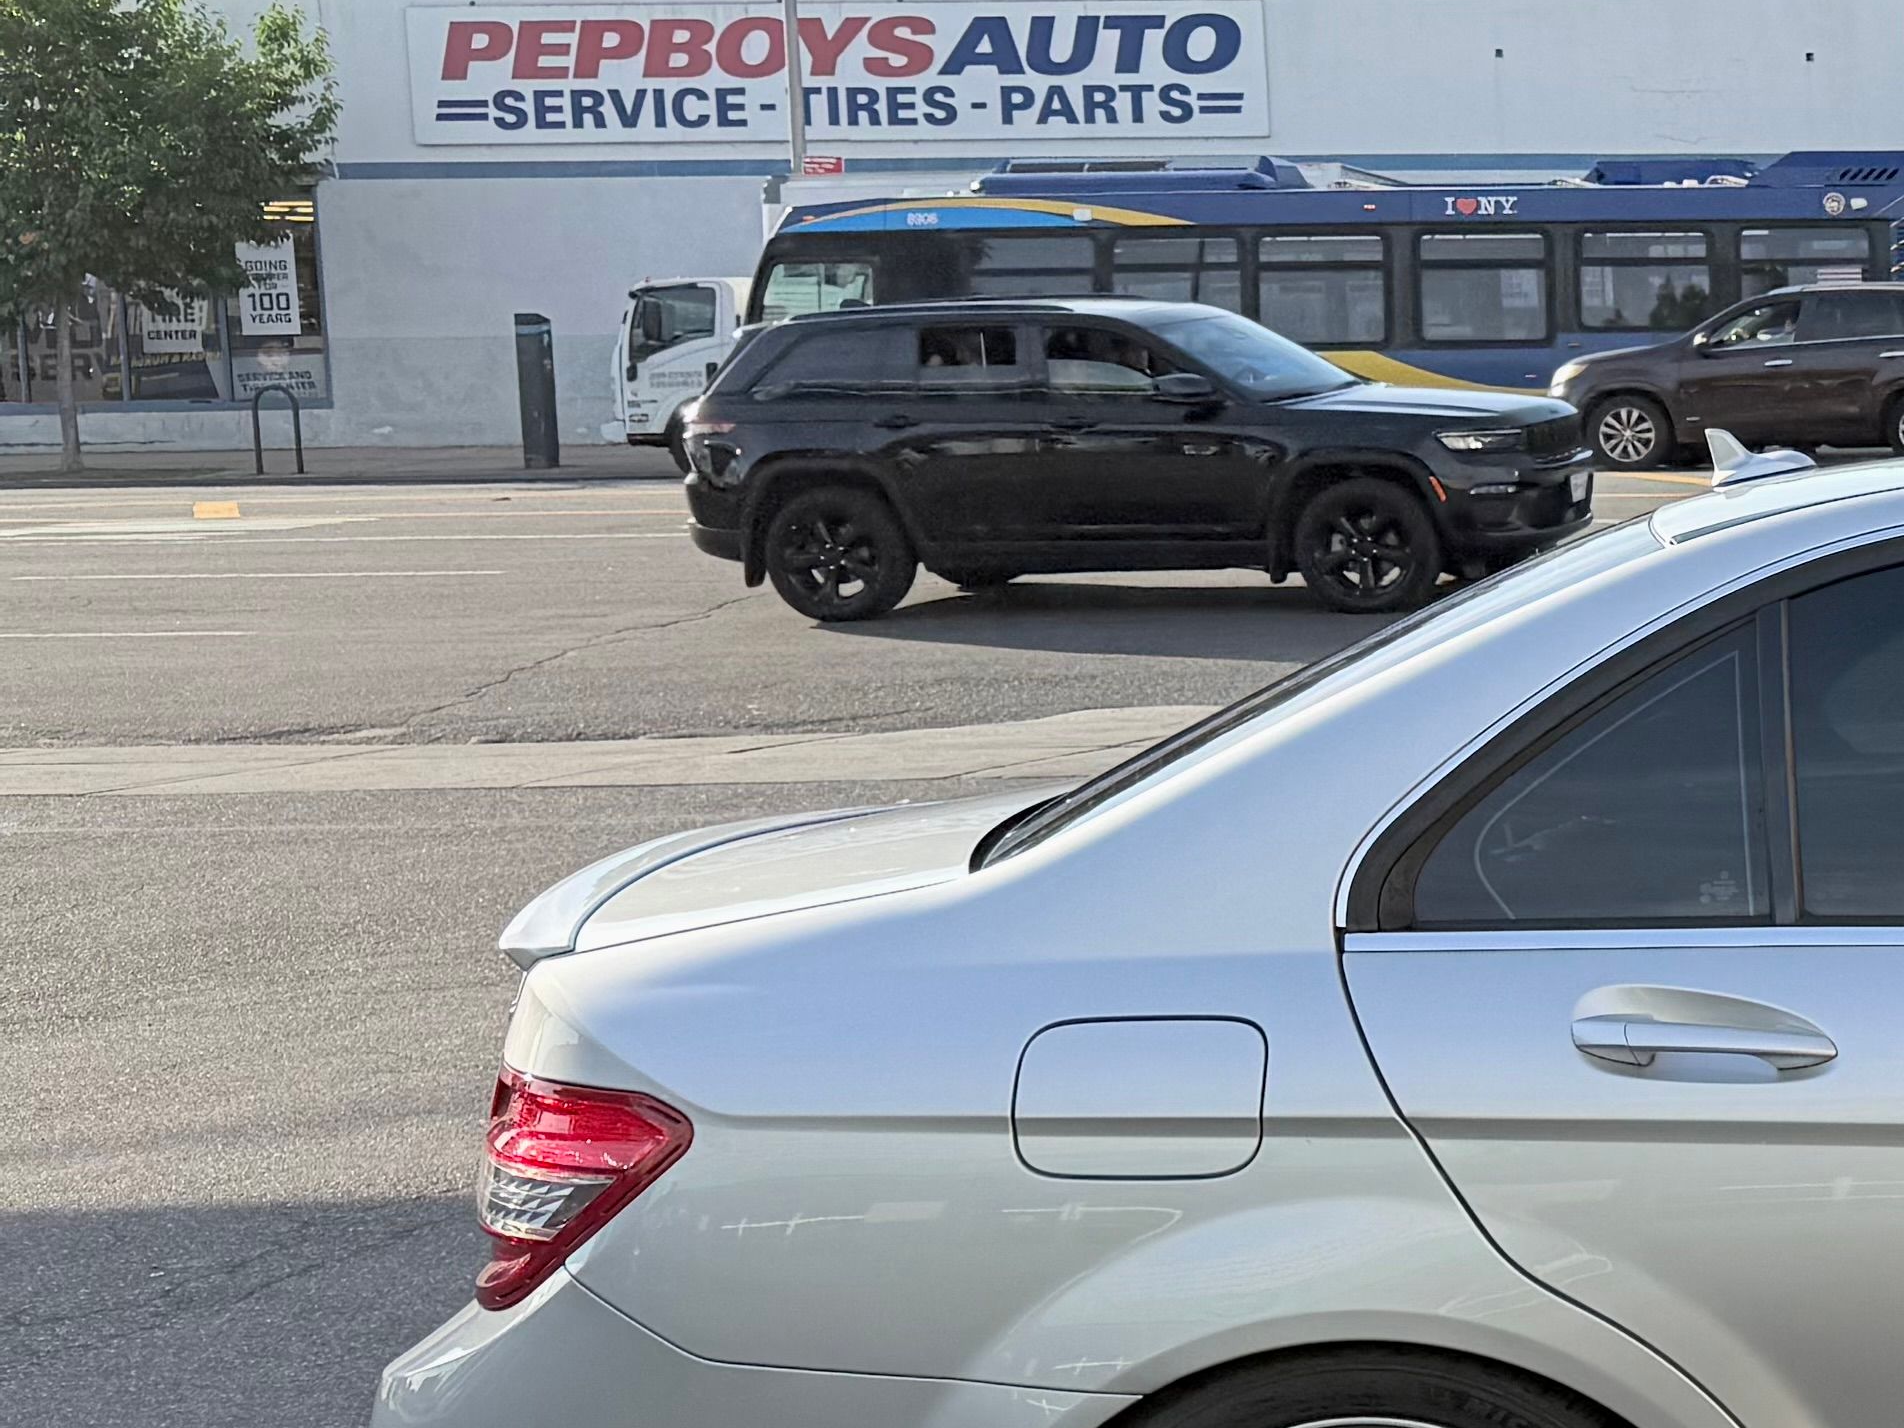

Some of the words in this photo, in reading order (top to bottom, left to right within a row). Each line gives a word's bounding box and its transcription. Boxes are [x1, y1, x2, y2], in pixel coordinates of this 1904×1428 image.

[441, 16, 936, 81] PEPBOYS
[937, 13, 1243, 76] AUTO
[492, 86, 749, 131] SERVICE
[801, 84, 958, 128] TIRES
[1000, 82, 1194, 126] PARTS
[1444, 196, 1456, 215] I
[247, 292, 291, 312] 100
[249, 312, 292, 325] YEARS
[147, 329, 198, 341] CENTER
